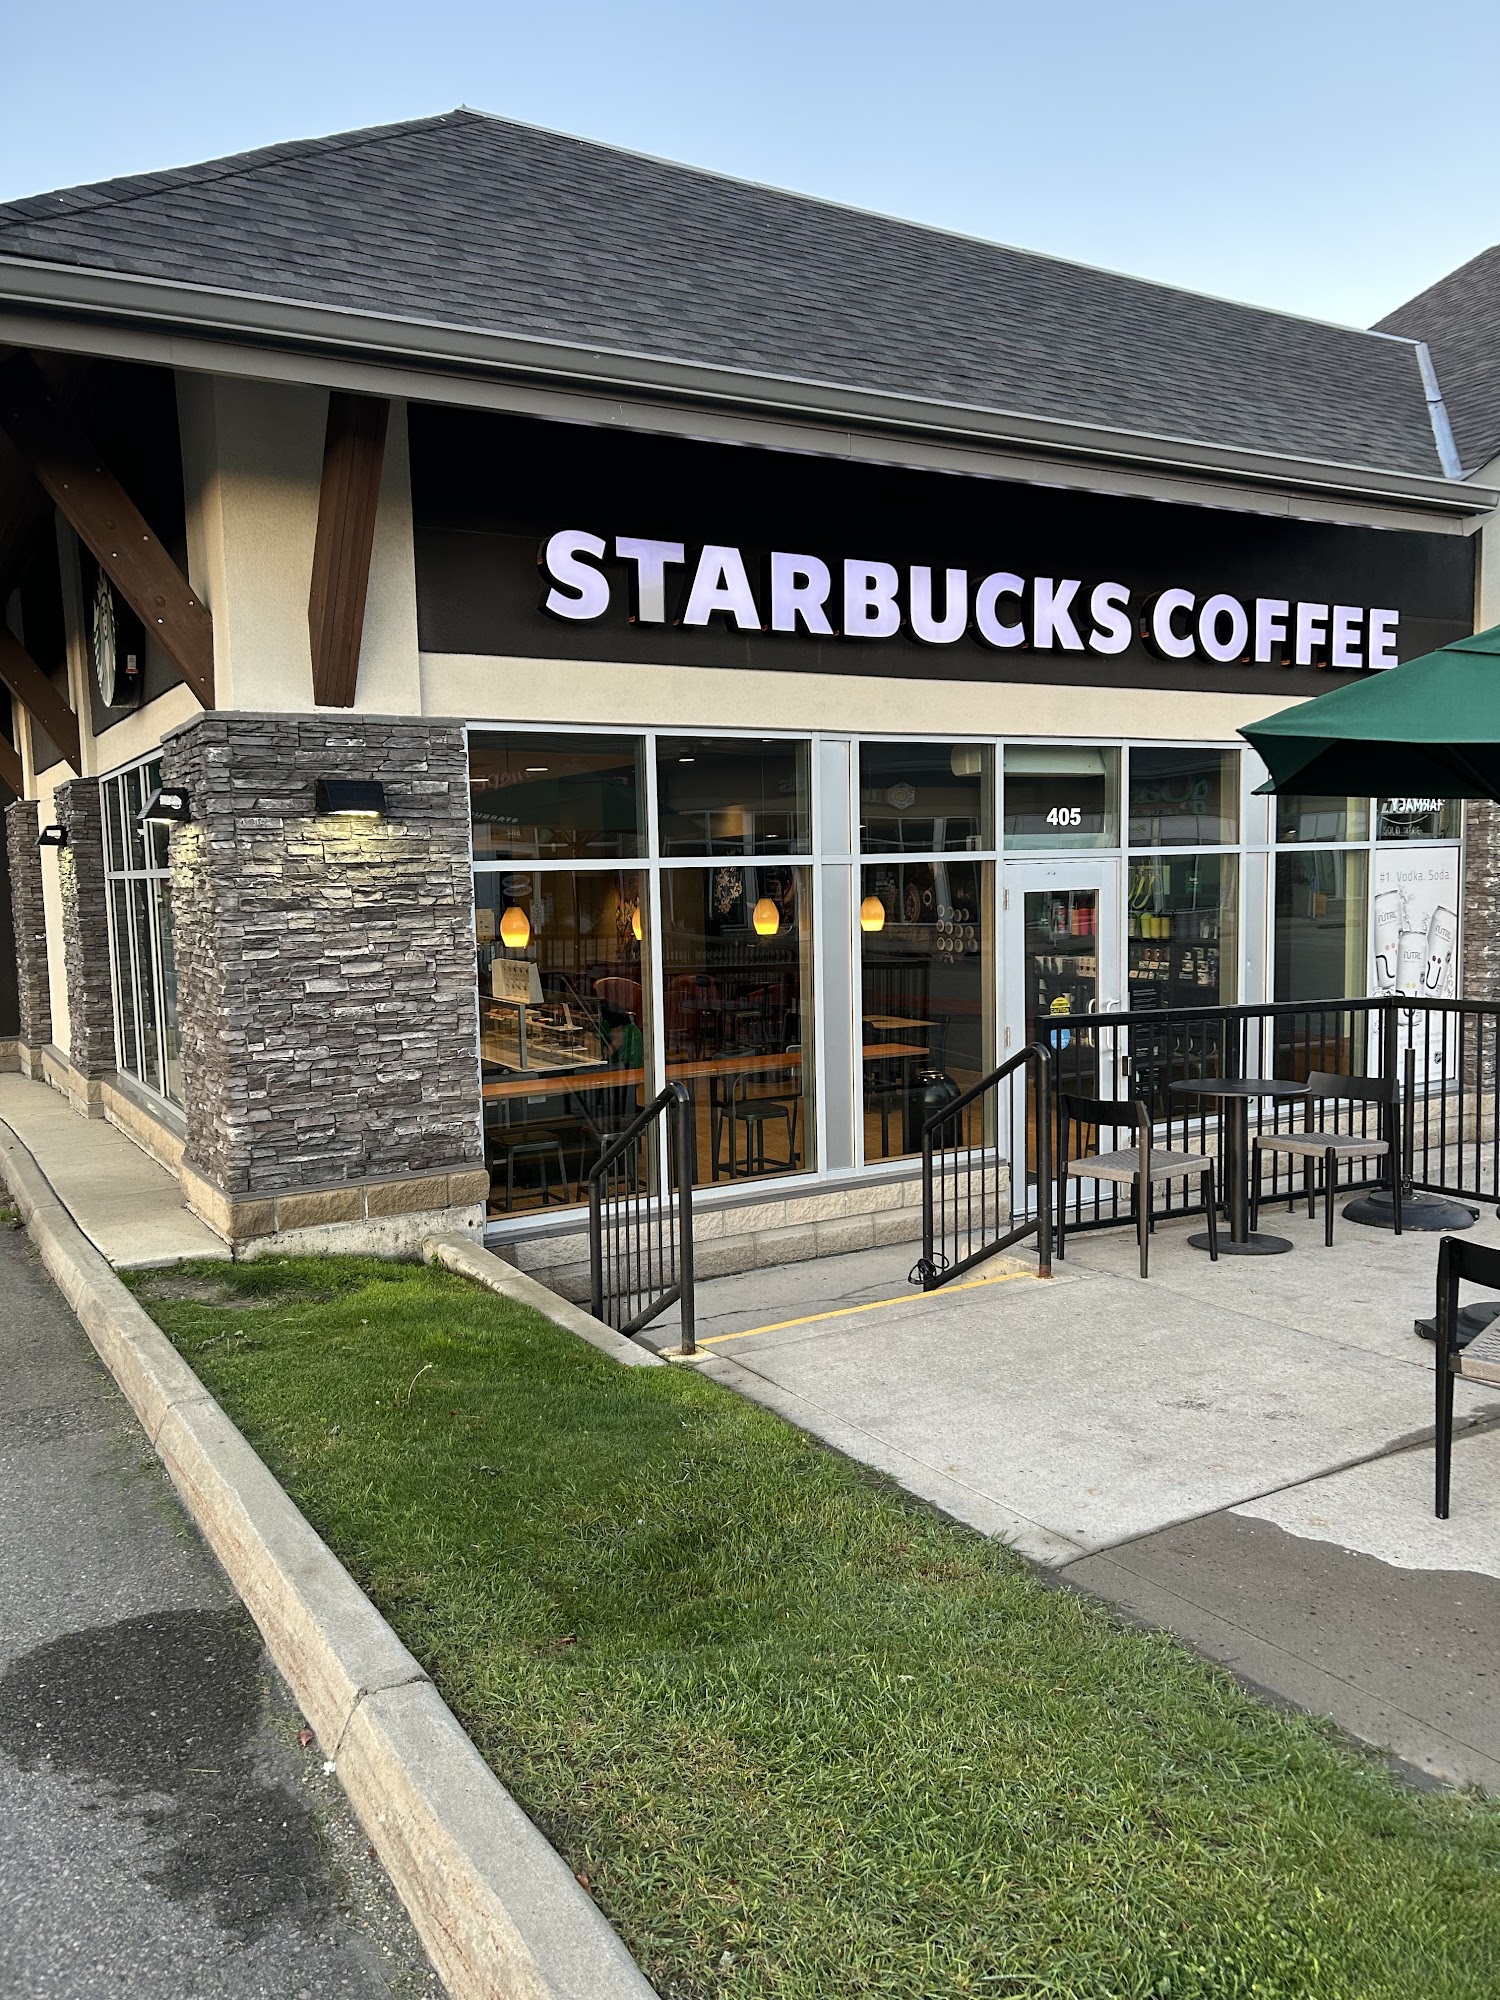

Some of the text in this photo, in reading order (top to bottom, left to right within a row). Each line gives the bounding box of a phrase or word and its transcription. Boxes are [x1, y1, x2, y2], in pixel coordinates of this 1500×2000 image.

[545, 529, 1399, 669] STARBUCKS COFFEE
[1046, 807, 1081, 826] 405
[1379, 868, 1452, 883] #1. Vodka. Soda.
